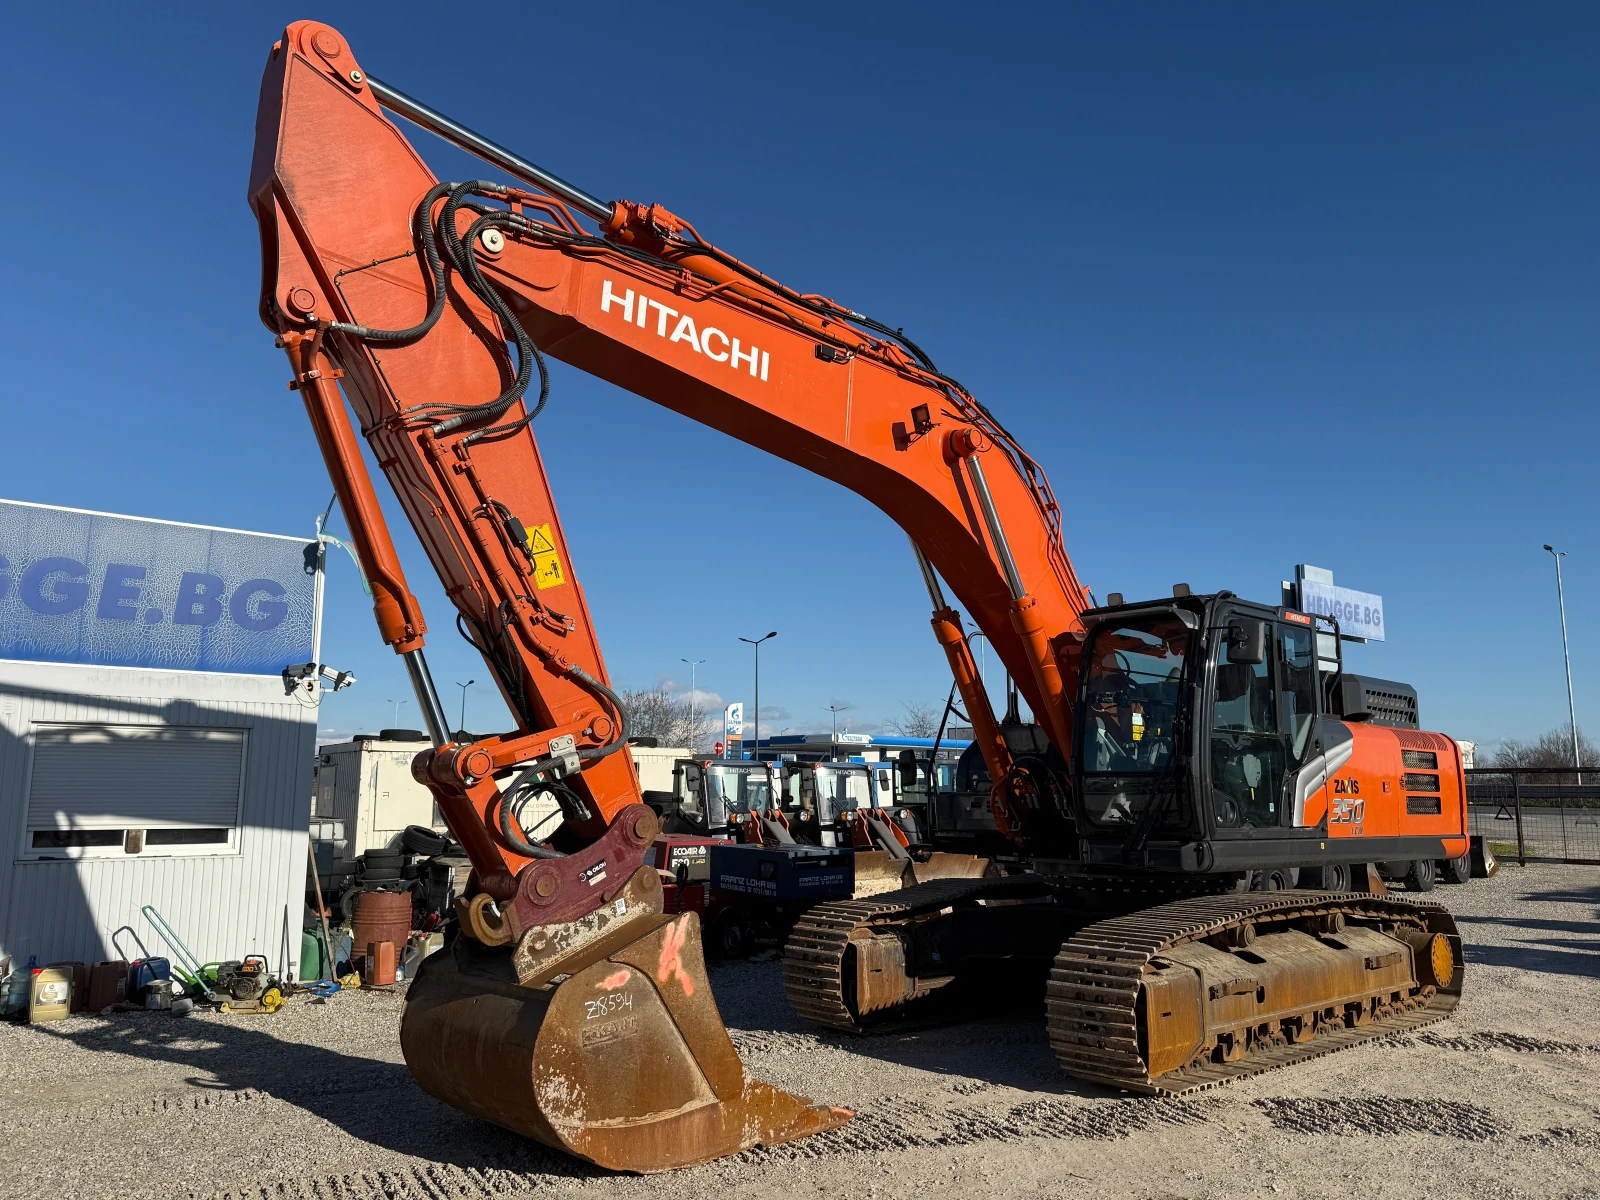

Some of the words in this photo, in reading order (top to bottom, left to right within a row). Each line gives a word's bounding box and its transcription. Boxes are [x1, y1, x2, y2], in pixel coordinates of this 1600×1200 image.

[600, 279, 770, 382] HITACHI
[0, 553, 288, 632] GE.BG
[1305, 593, 1381, 627] HENGGE.BG
[729, 767, 753, 775] HITACHI
[1330, 798, 1365, 824] 350
[673, 847, 698, 856] ECOAIR
